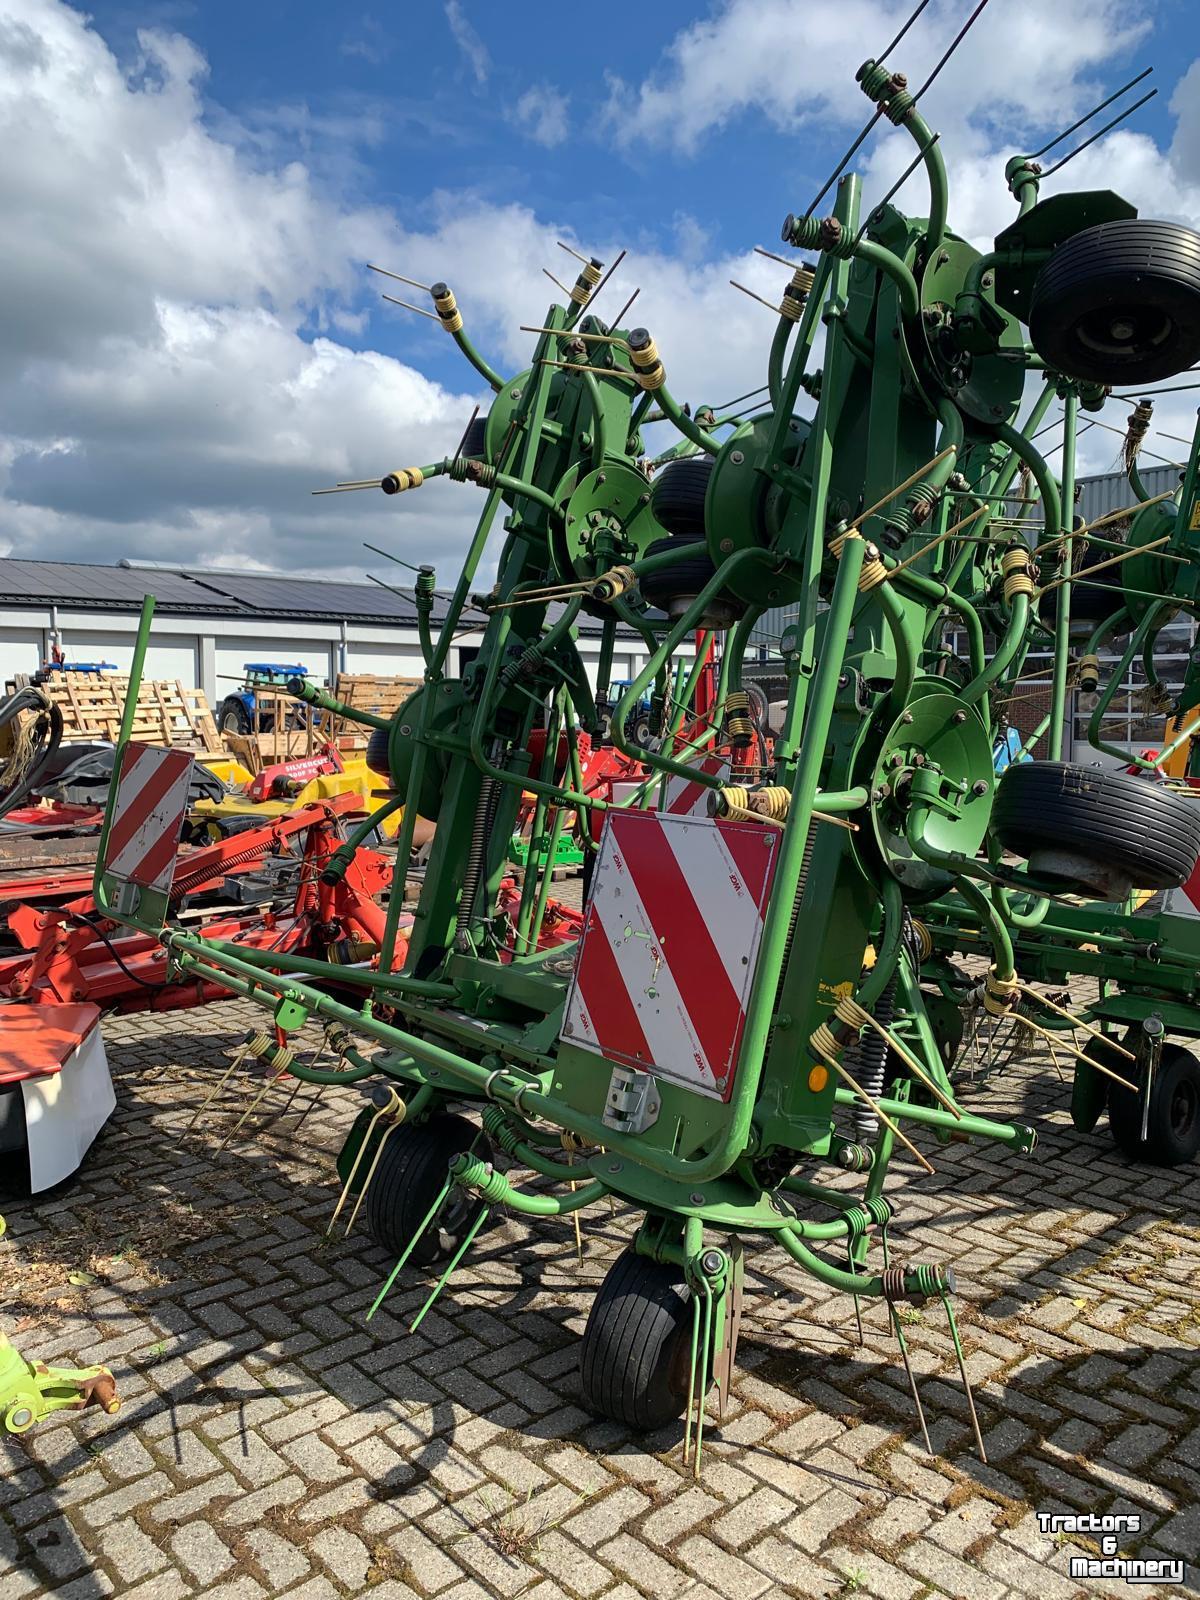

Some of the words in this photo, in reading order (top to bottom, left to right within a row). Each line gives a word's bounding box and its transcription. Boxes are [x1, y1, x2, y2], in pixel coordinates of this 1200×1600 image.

[285, 757, 328, 771] SILVERCUT
[729, 874, 741, 892] WGF
[693, 1052, 705, 1072] WGF
